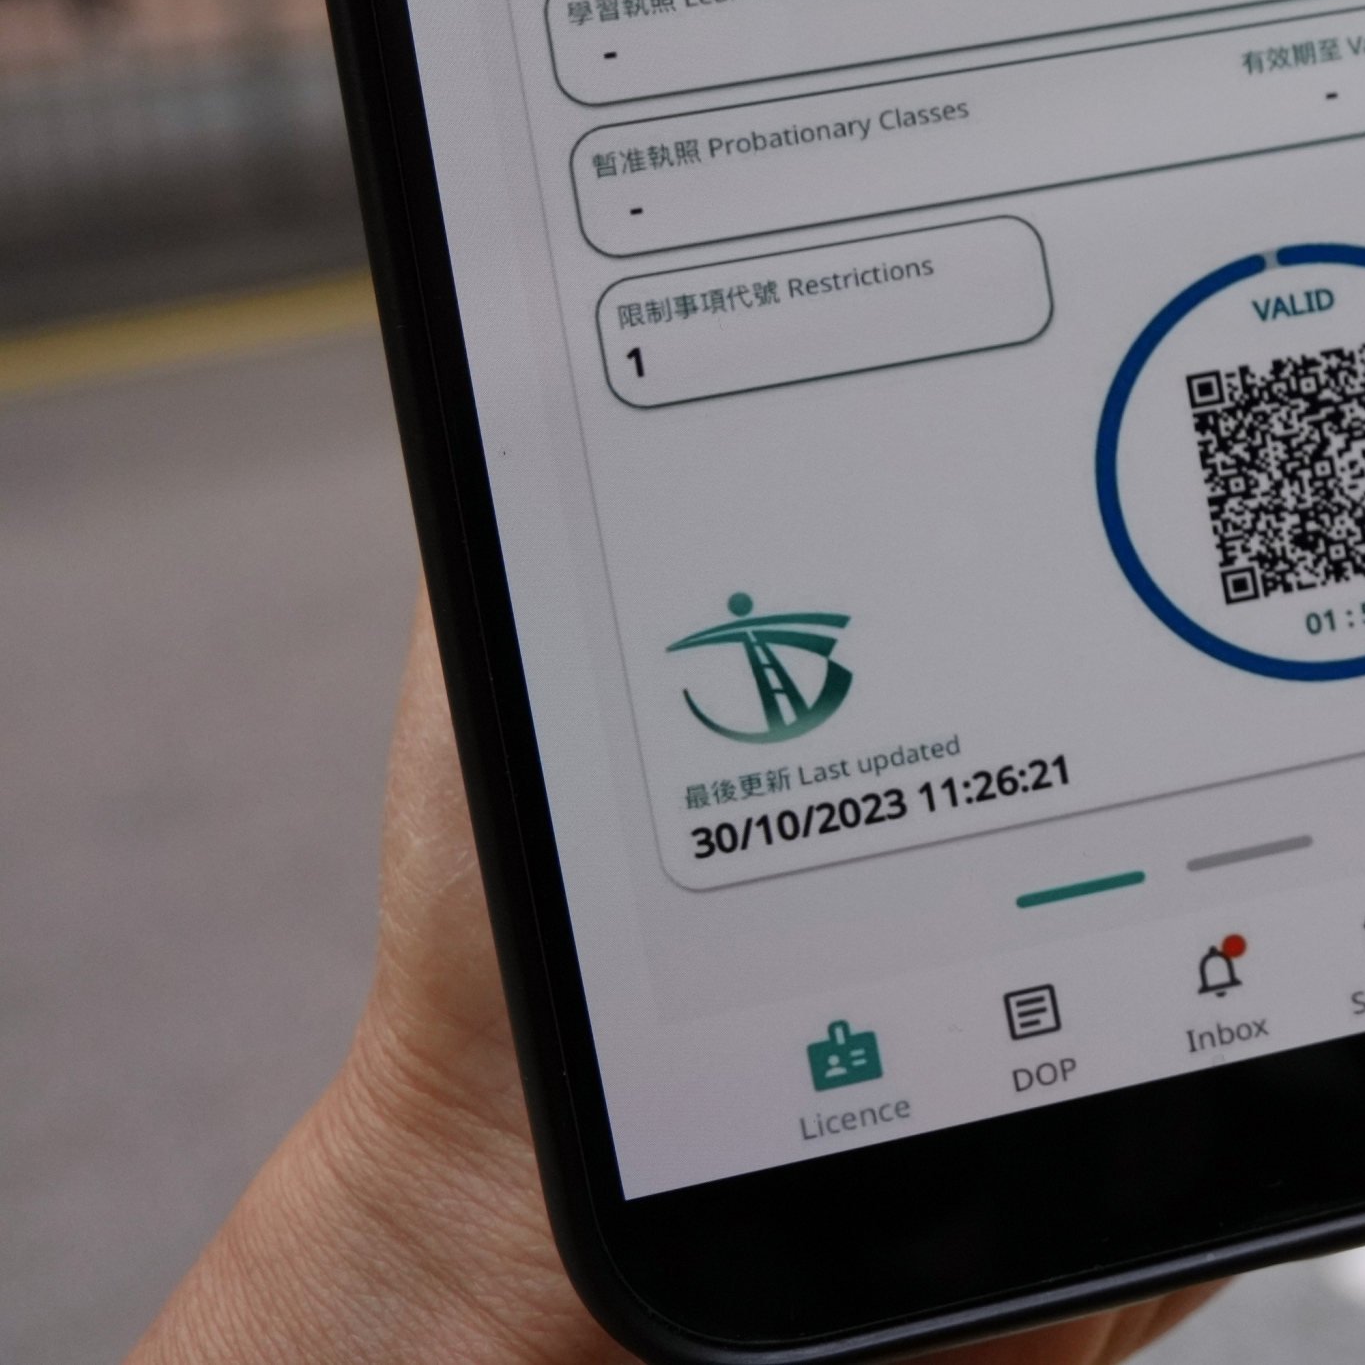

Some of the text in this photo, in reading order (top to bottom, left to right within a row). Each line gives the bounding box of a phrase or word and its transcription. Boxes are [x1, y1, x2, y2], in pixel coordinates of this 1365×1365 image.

[1241, 36, 1343, 75] 有效期至
[708, 115, 872, 160] Probationary
[878, 100, 969, 132] Classes
[617, 257, 935, 330] 限制事項代號 Restrictions
[1252, 288, 1335, 322] VALID
[625, 346, 646, 377] 1
[685, 735, 961, 810] 最後更新 Last updated
[690, 754, 1071, 859] 30/10/2023 11:26:21
[1185, 1017, 1270, 1053] Inbox
[1011, 1057, 1078, 1092] DOP
[799, 1096, 912, 1141] Licence
